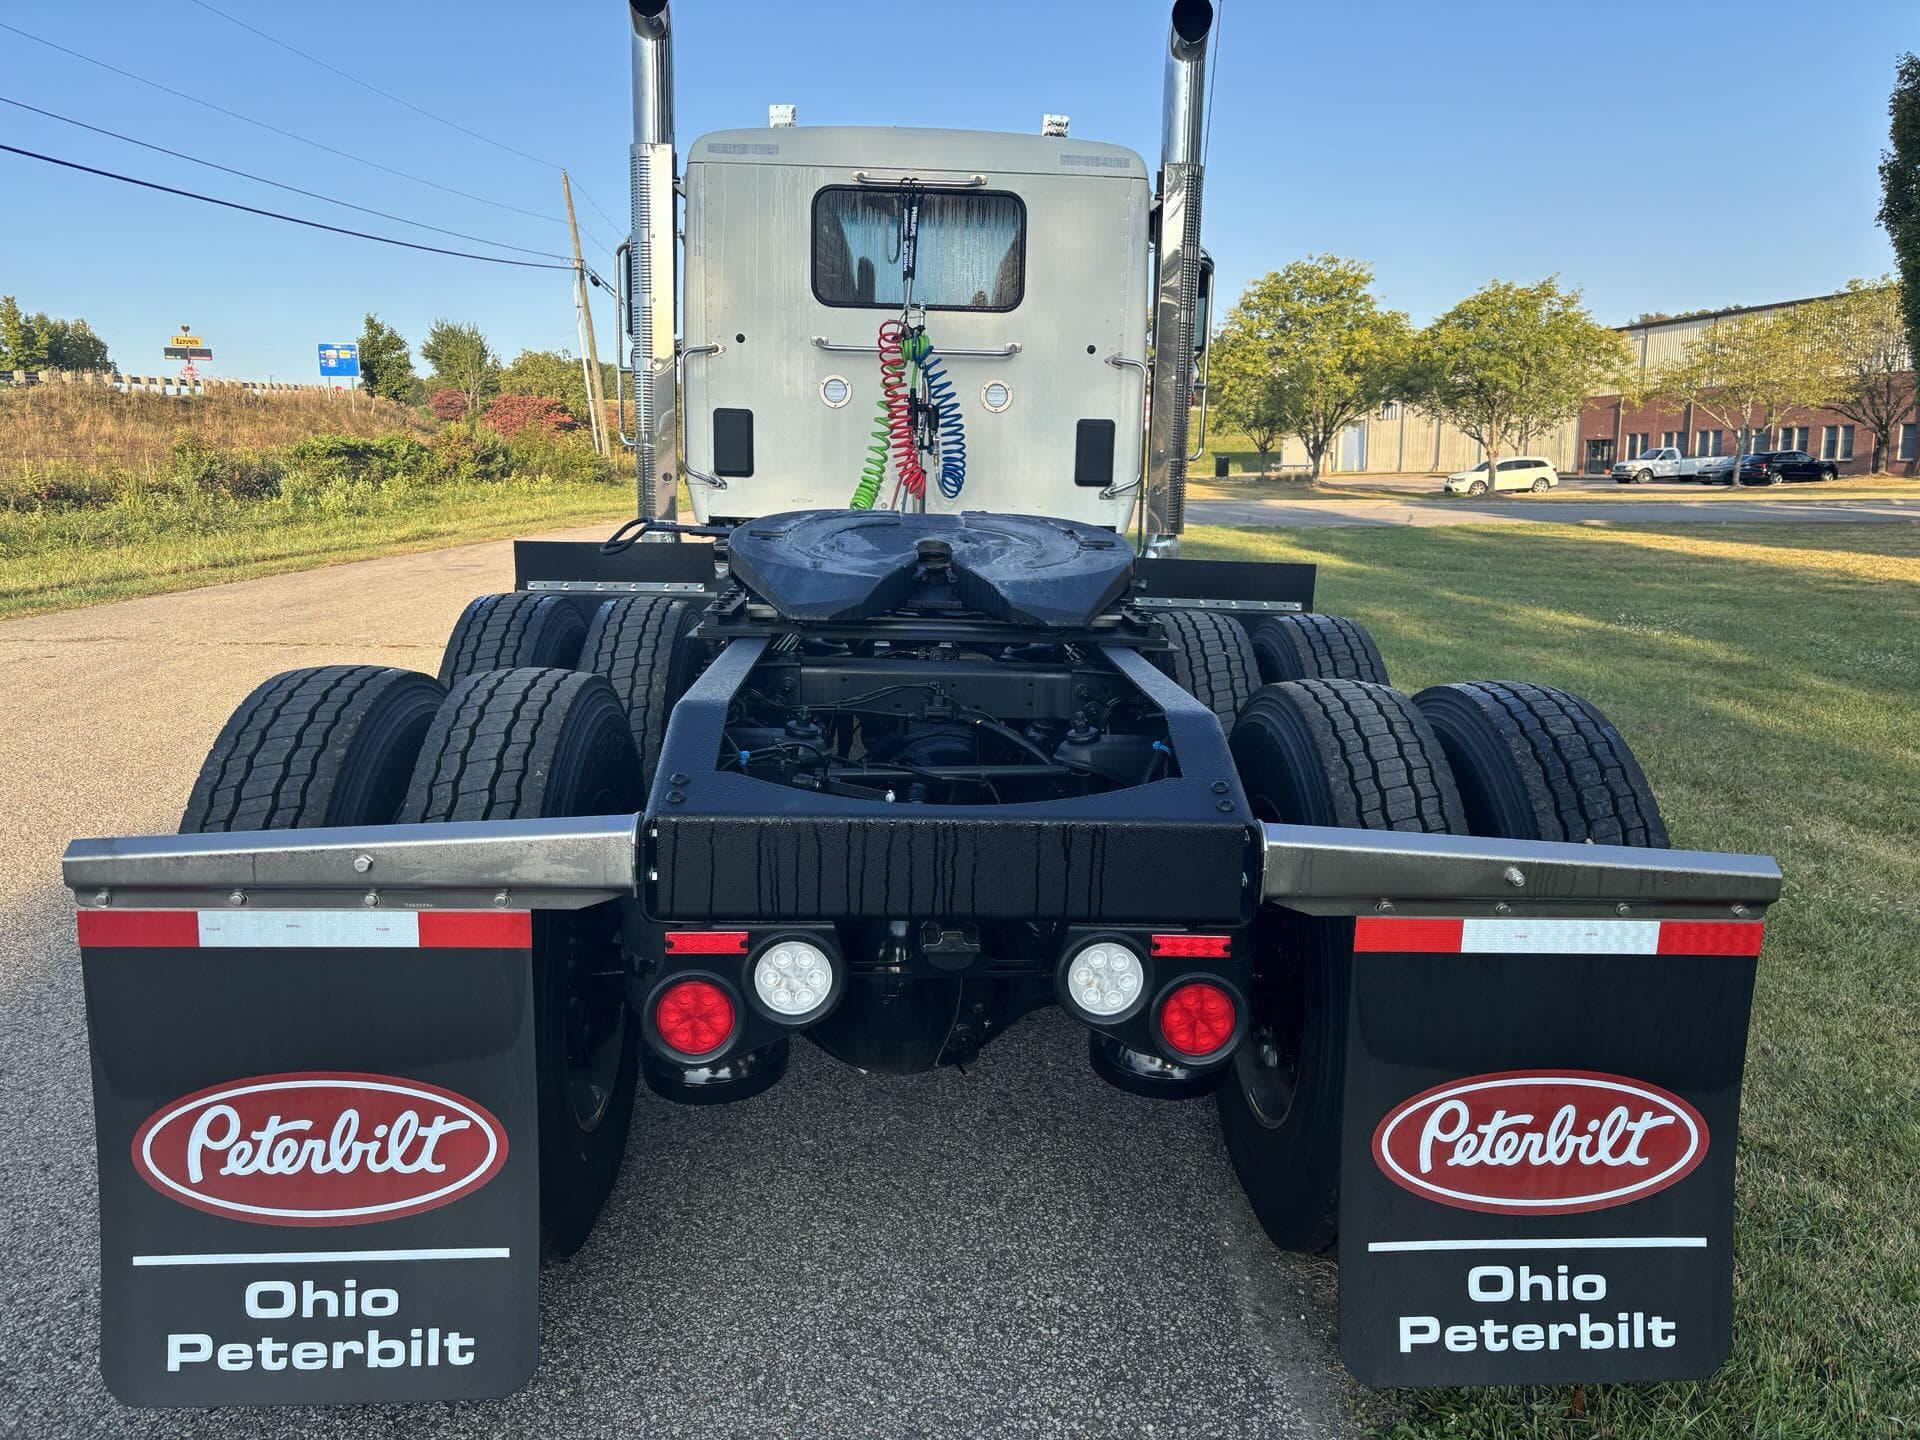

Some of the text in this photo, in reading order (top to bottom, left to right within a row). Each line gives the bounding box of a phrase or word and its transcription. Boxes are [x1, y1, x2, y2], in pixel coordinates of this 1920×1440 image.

[187, 1105, 470, 1184] Peterbilt
[1418, 1099, 1676, 1174] Peterbilt
[245, 1279, 399, 1319] Ohio
[1467, 1264, 1607, 1303] Ohio
[166, 1327, 475, 1372] Peterbilt
[1399, 1311, 1676, 1353] Peterbilt
